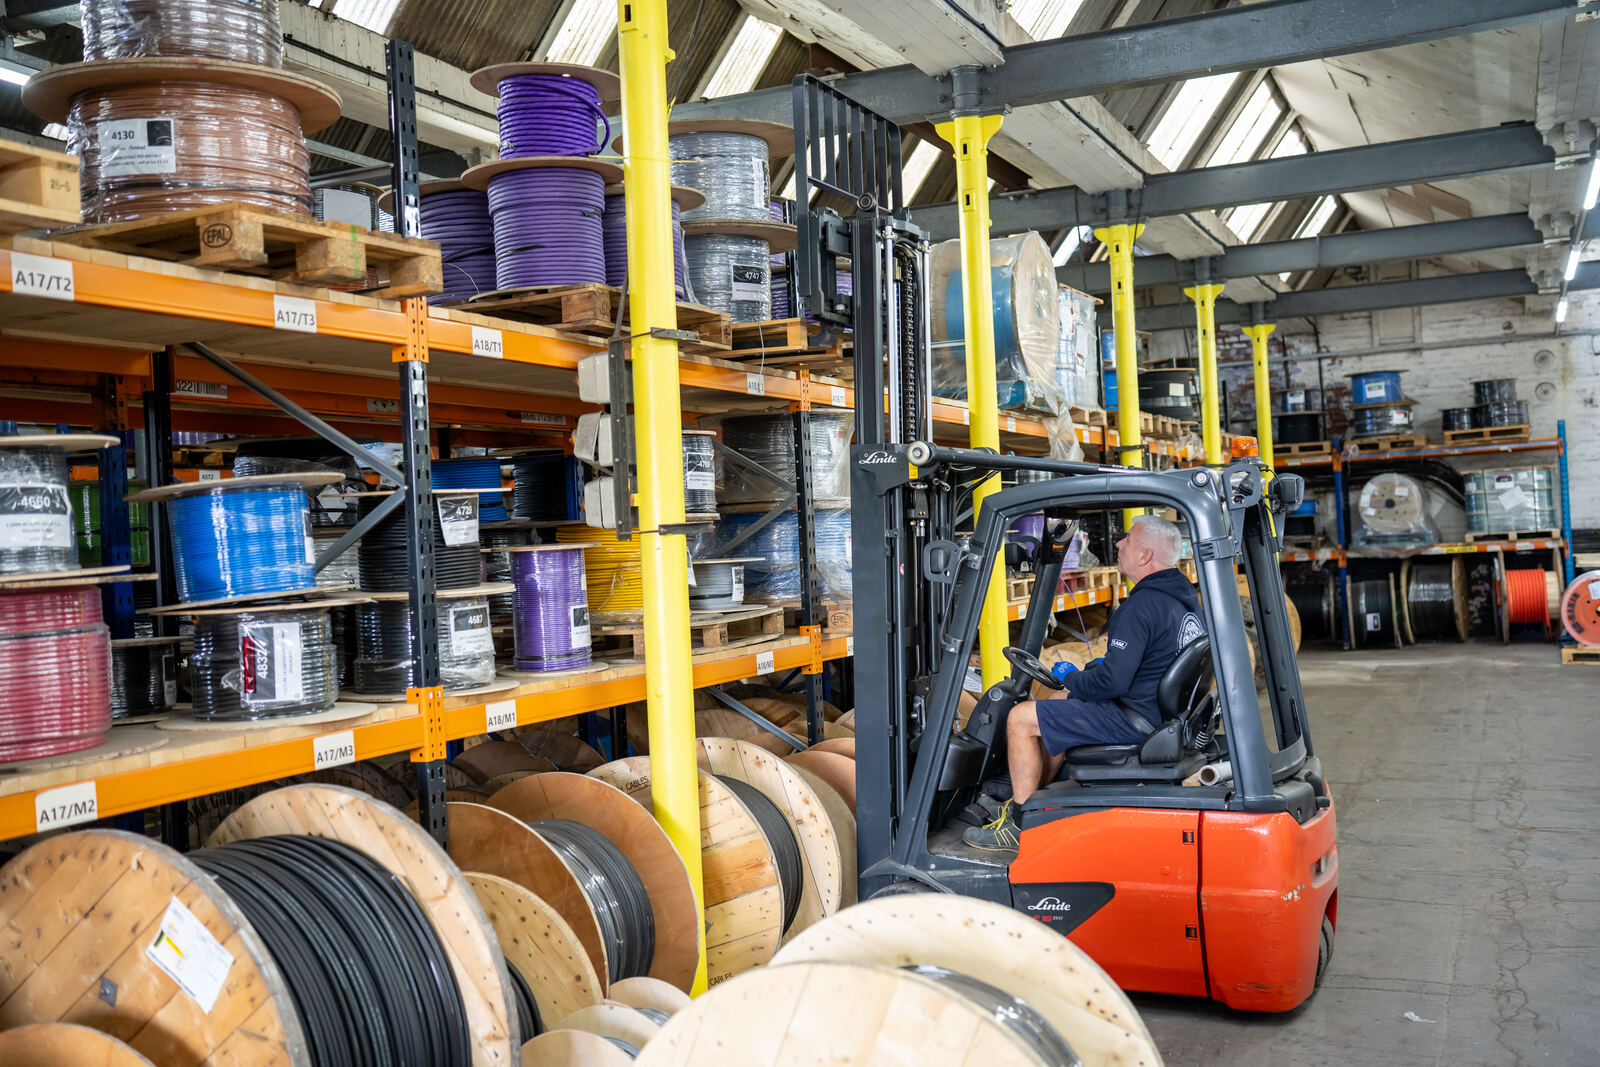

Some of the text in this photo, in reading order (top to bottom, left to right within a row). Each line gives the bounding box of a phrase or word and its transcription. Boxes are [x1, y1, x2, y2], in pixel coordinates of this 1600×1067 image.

[111, 130, 135, 140] 4130
[207, 228, 230, 243] EPAL
[15, 269, 72, 292] A17/T2
[276, 310, 316, 327] A17/T3
[474, 339, 501, 353] A18/T1
[858, 451, 898, 465] Linde
[488, 712, 516, 727] A18/M1
[316, 745, 354, 763] A17/M3
[625, 775, 650, 791] CABLES
[39, 800, 96, 824] A17/M2
[1027, 896, 1071, 911] Linde
